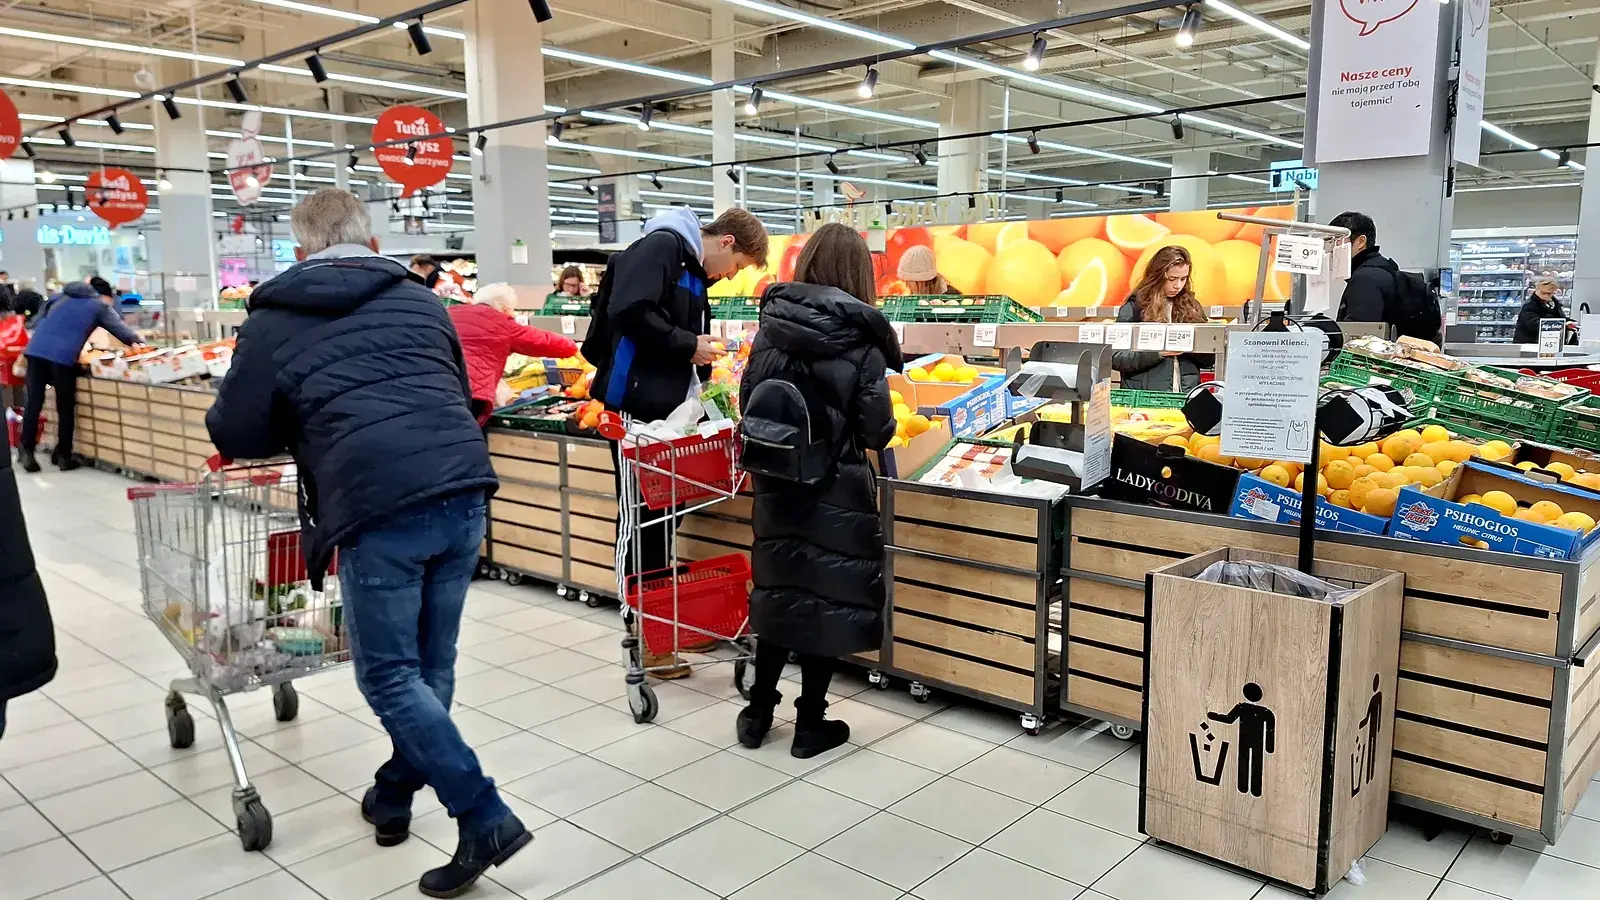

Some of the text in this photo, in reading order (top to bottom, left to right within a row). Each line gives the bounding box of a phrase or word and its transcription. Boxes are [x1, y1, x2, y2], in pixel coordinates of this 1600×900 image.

[1340, 65, 1413, 82] Nasze ceny
[1331, 79, 1420, 96] nie mają przed Tobą
[1350, 96, 1393, 108] tajemnic!
[1281, 339, 1309, 347] Klienci,
[1116, 470, 1213, 511] LADYGODIVA
[1277, 493, 1340, 521] PSIHIOS
[1409, 504, 1434, 516] Best
[1443, 508, 1519, 537] PSIHOGIOS
[1452, 523, 1504, 543] HELLENIC CITRUS
